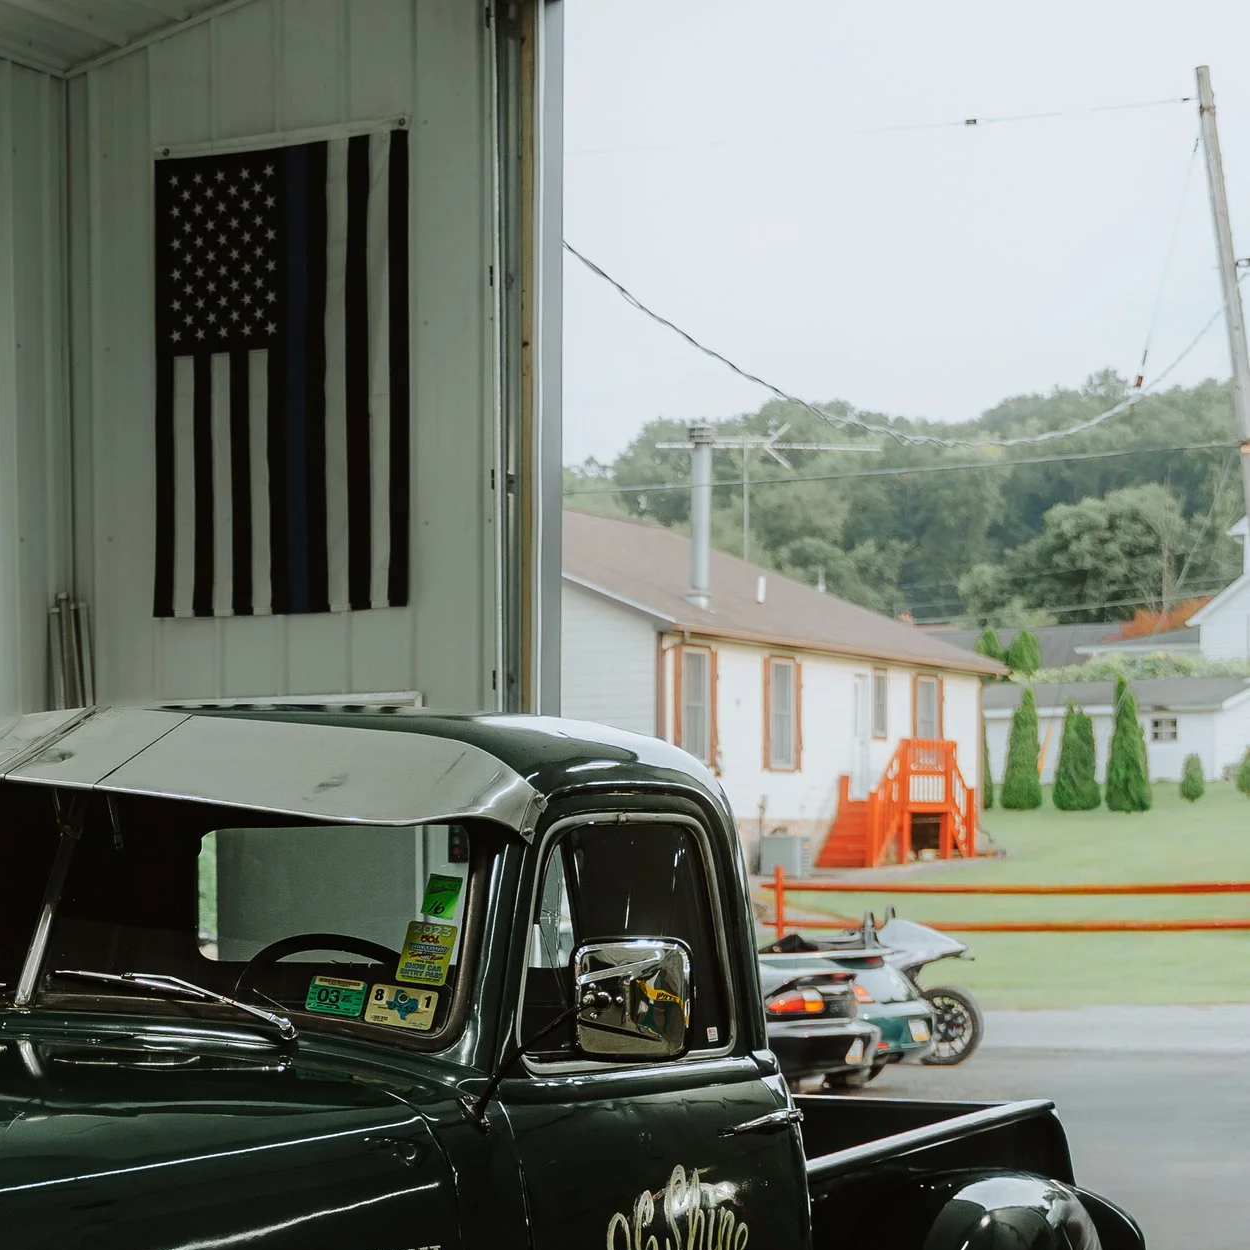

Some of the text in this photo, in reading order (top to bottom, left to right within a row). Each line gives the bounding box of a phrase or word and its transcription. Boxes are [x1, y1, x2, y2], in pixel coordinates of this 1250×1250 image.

[414, 924, 452, 937] 2023
[374, 989, 432, 1008] 8 1
